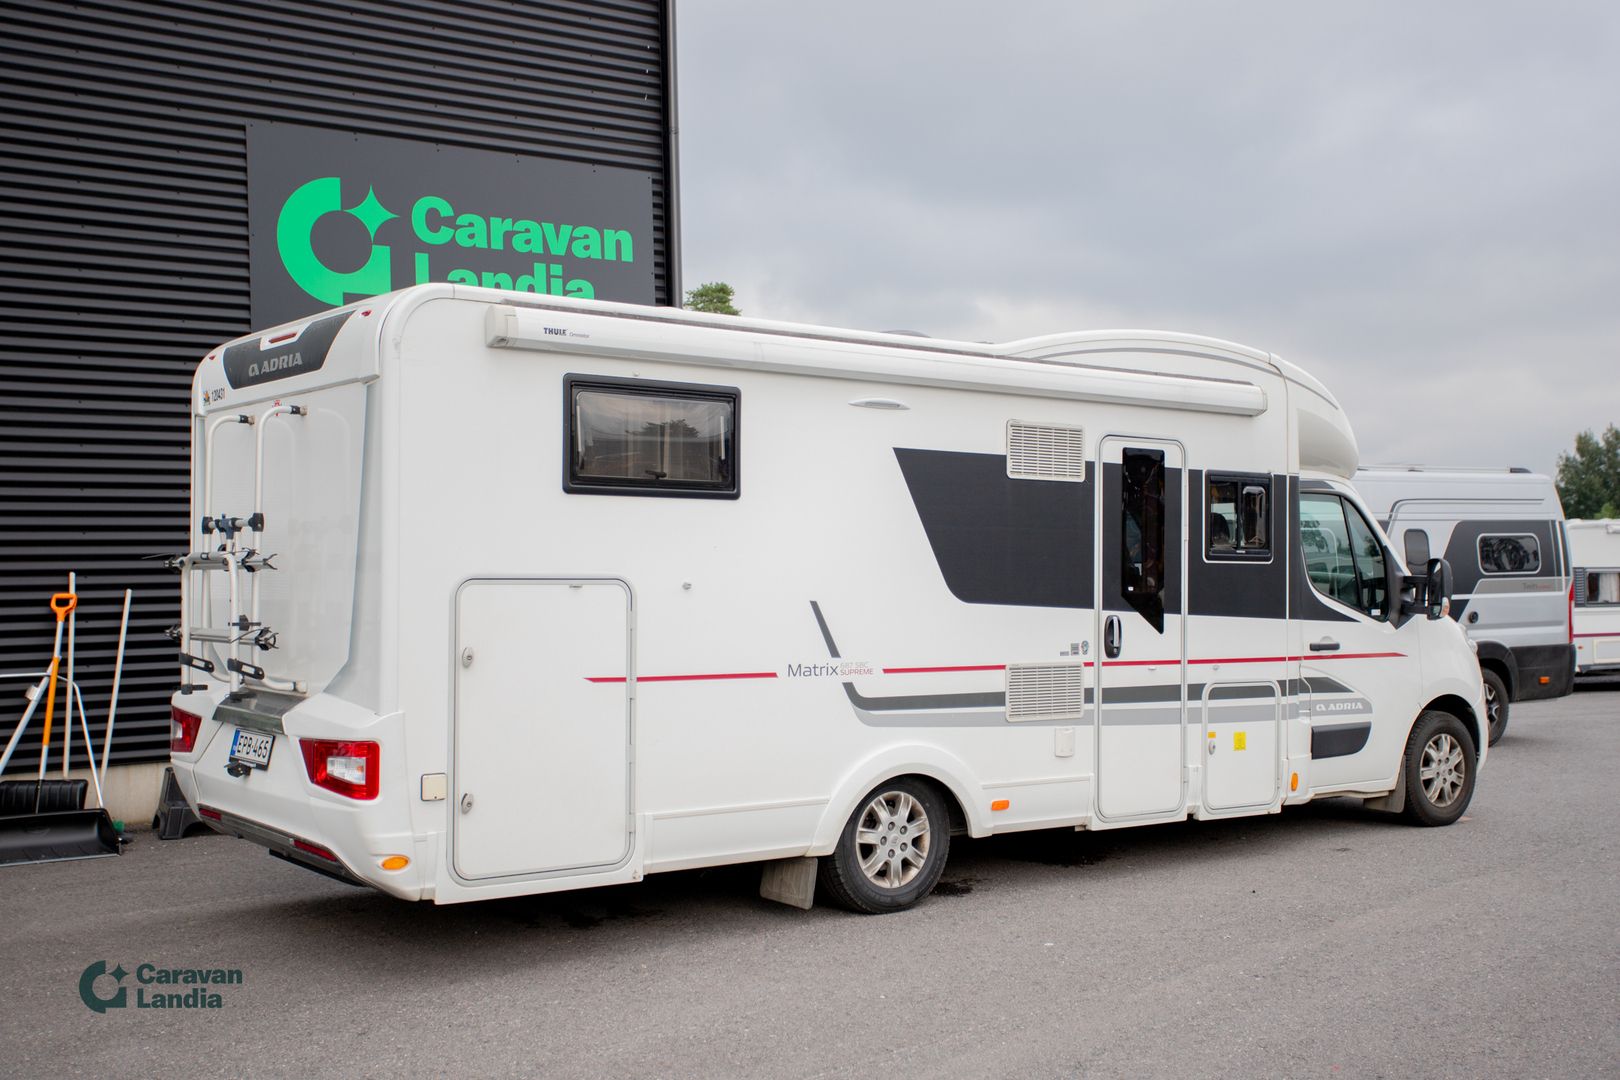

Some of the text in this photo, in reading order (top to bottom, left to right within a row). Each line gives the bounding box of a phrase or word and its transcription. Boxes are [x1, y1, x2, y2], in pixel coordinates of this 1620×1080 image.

[411, 195, 634, 263] Caravan
[543, 327, 567, 336] THULE
[261, 352, 302, 374] ADRIA
[787, 662, 839, 678] Matrix
[840, 668, 874, 676] SUPREME
[1328, 702, 1363, 711] ADRIA
[237, 735, 269, 759] EPB-465
